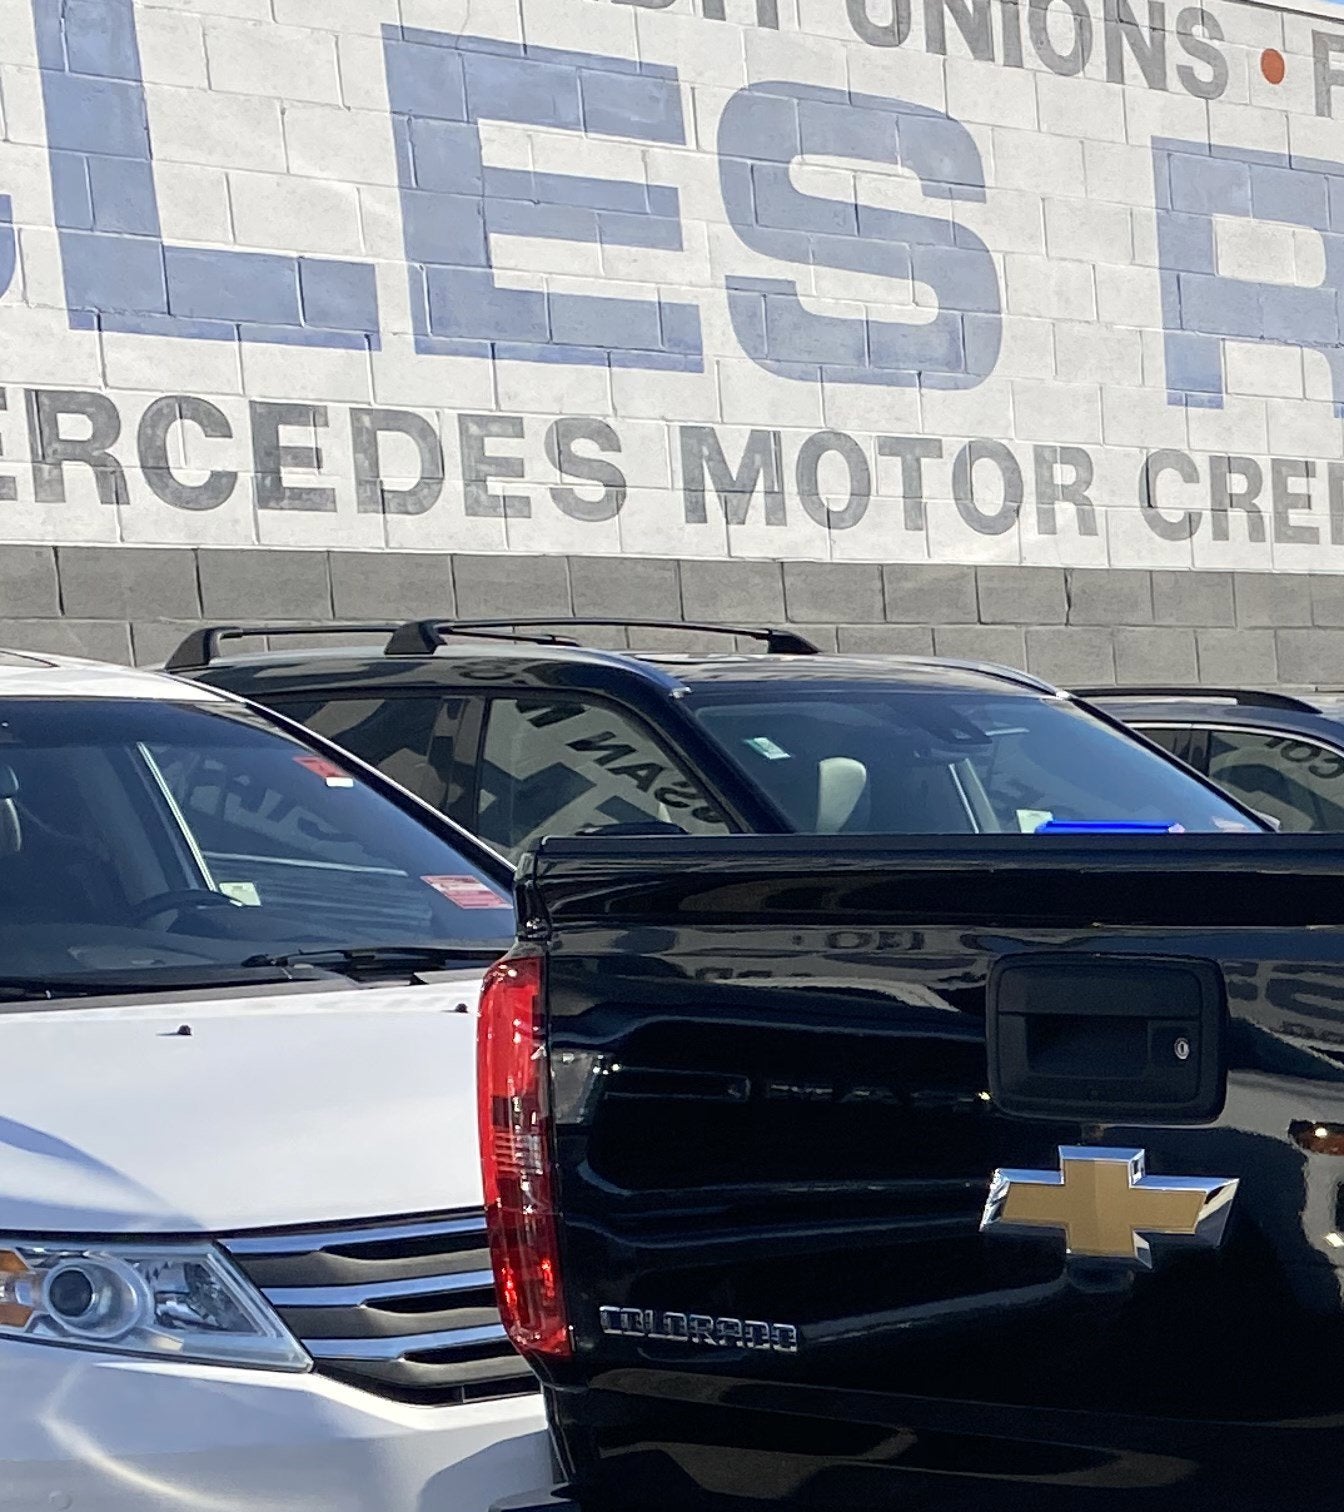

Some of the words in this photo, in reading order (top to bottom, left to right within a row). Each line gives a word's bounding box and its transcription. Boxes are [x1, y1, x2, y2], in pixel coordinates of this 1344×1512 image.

[0, 0, 1003, 391] LES
[0, 386, 628, 524] RCEDES
[679, 424, 1098, 537] MOTOR
[600, 1305, 798, 1352] COLORADO
